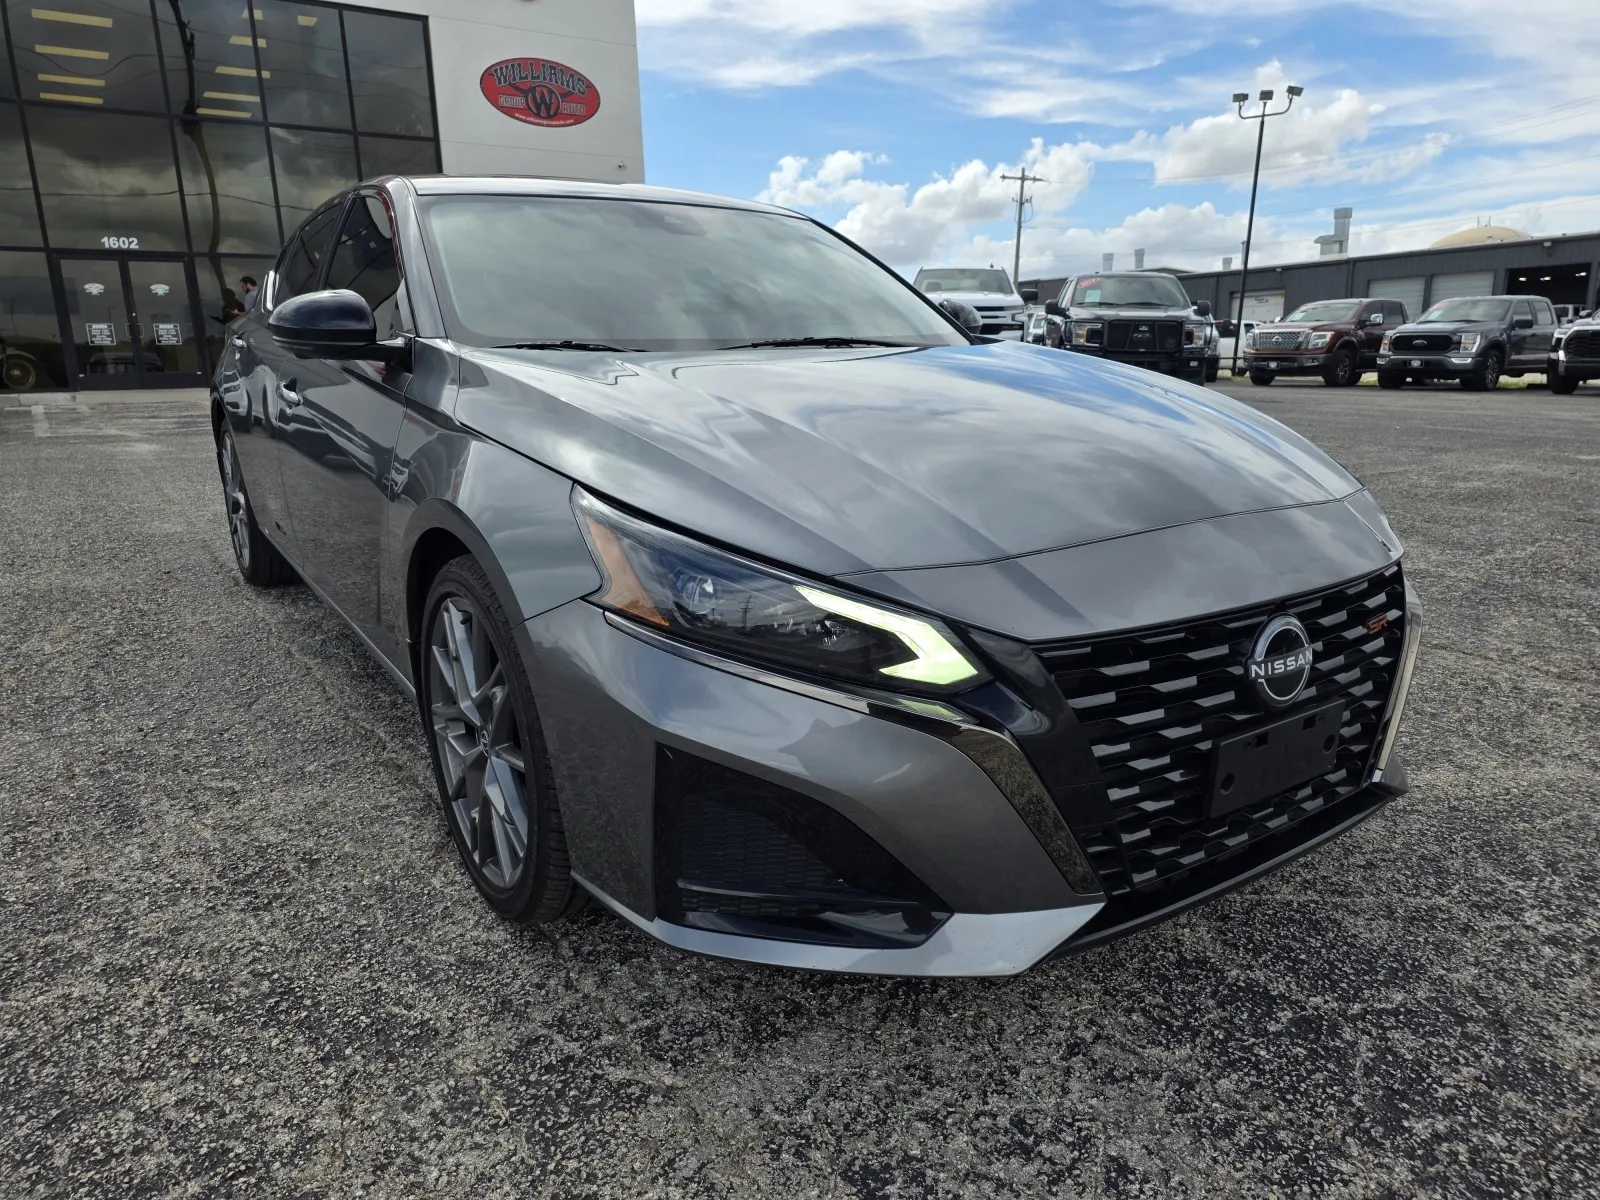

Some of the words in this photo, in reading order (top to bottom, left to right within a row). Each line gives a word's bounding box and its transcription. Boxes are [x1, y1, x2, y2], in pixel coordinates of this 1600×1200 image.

[493, 61, 586, 97] WILLIAMS
[499, 95, 526, 108] GROUP
[562, 102, 586, 115] AUTO
[101, 236, 139, 249] 1602
[1368, 613, 1388, 634] SR
[1251, 650, 1312, 678] NISSAN
